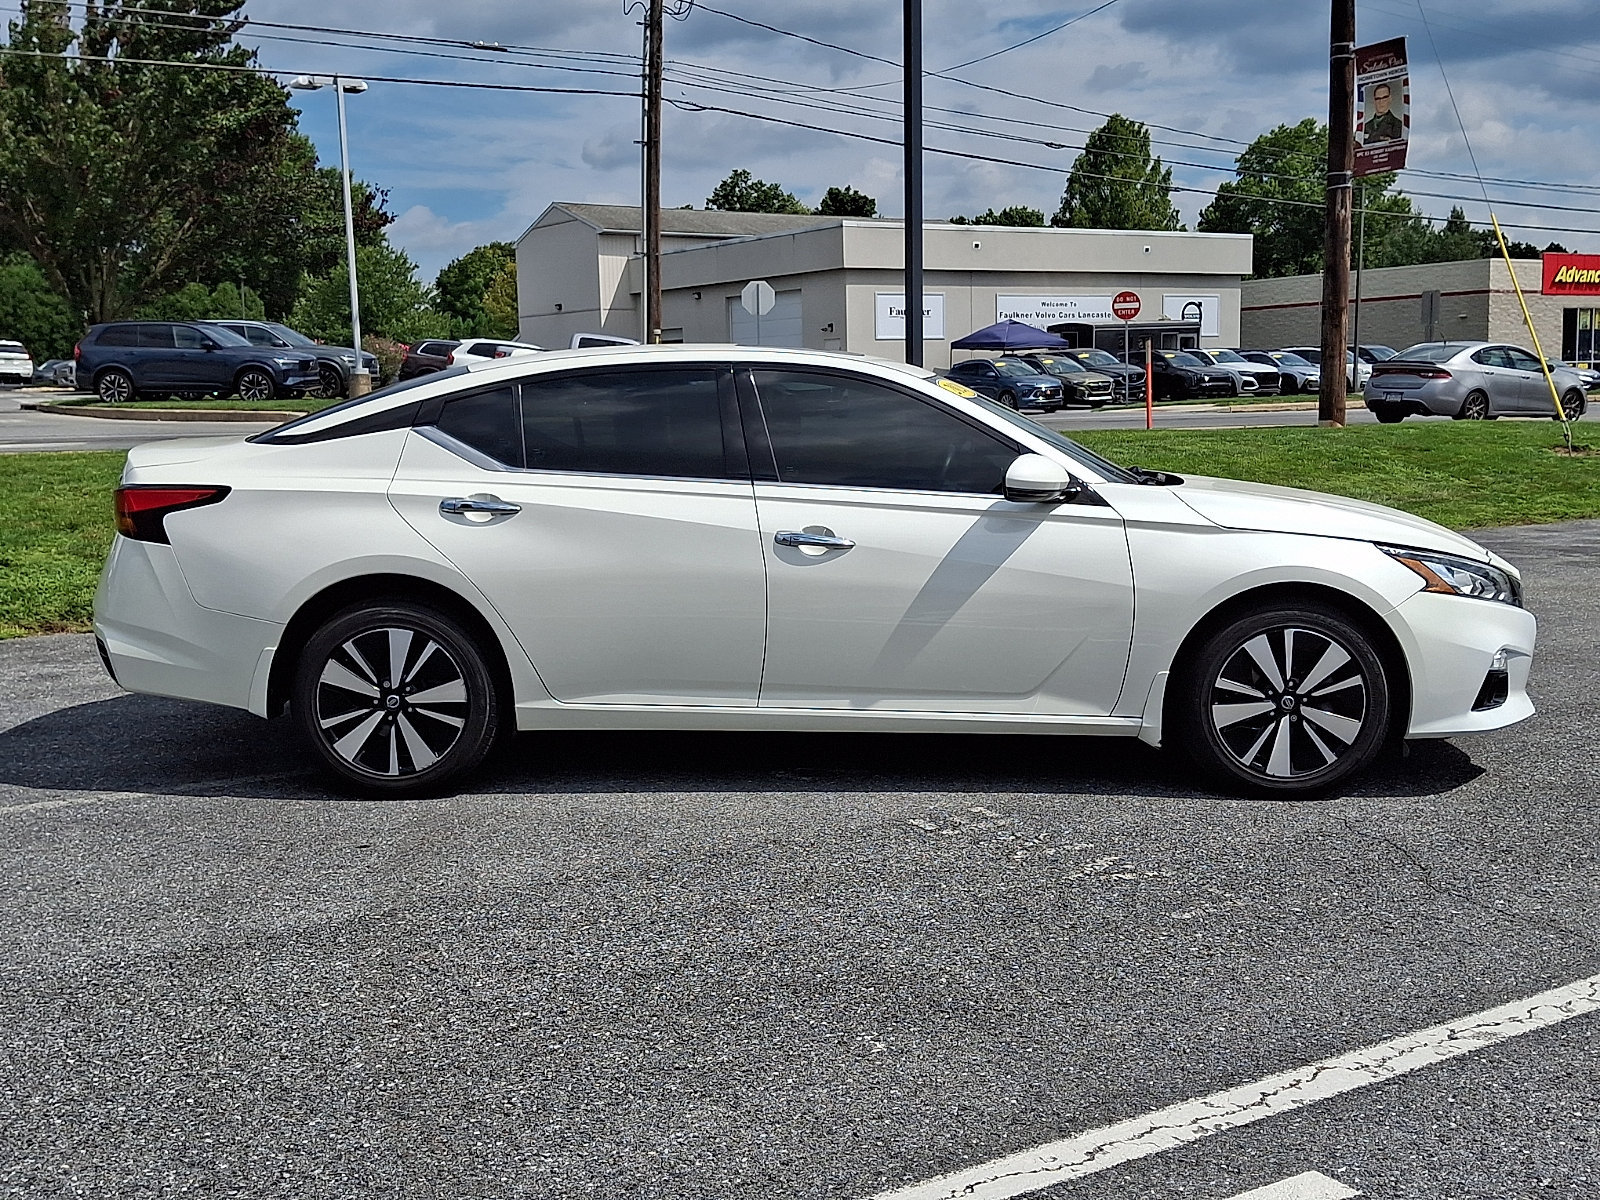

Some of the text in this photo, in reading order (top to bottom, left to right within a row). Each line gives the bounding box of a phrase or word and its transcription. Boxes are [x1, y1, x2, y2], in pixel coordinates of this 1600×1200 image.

[999, 311, 1033, 319] Faulkner
[1035, 311, 1056, 319] Volvo
[1058, 311, 1076, 319] Cars
[1117, 308, 1135, 316] ENTER
